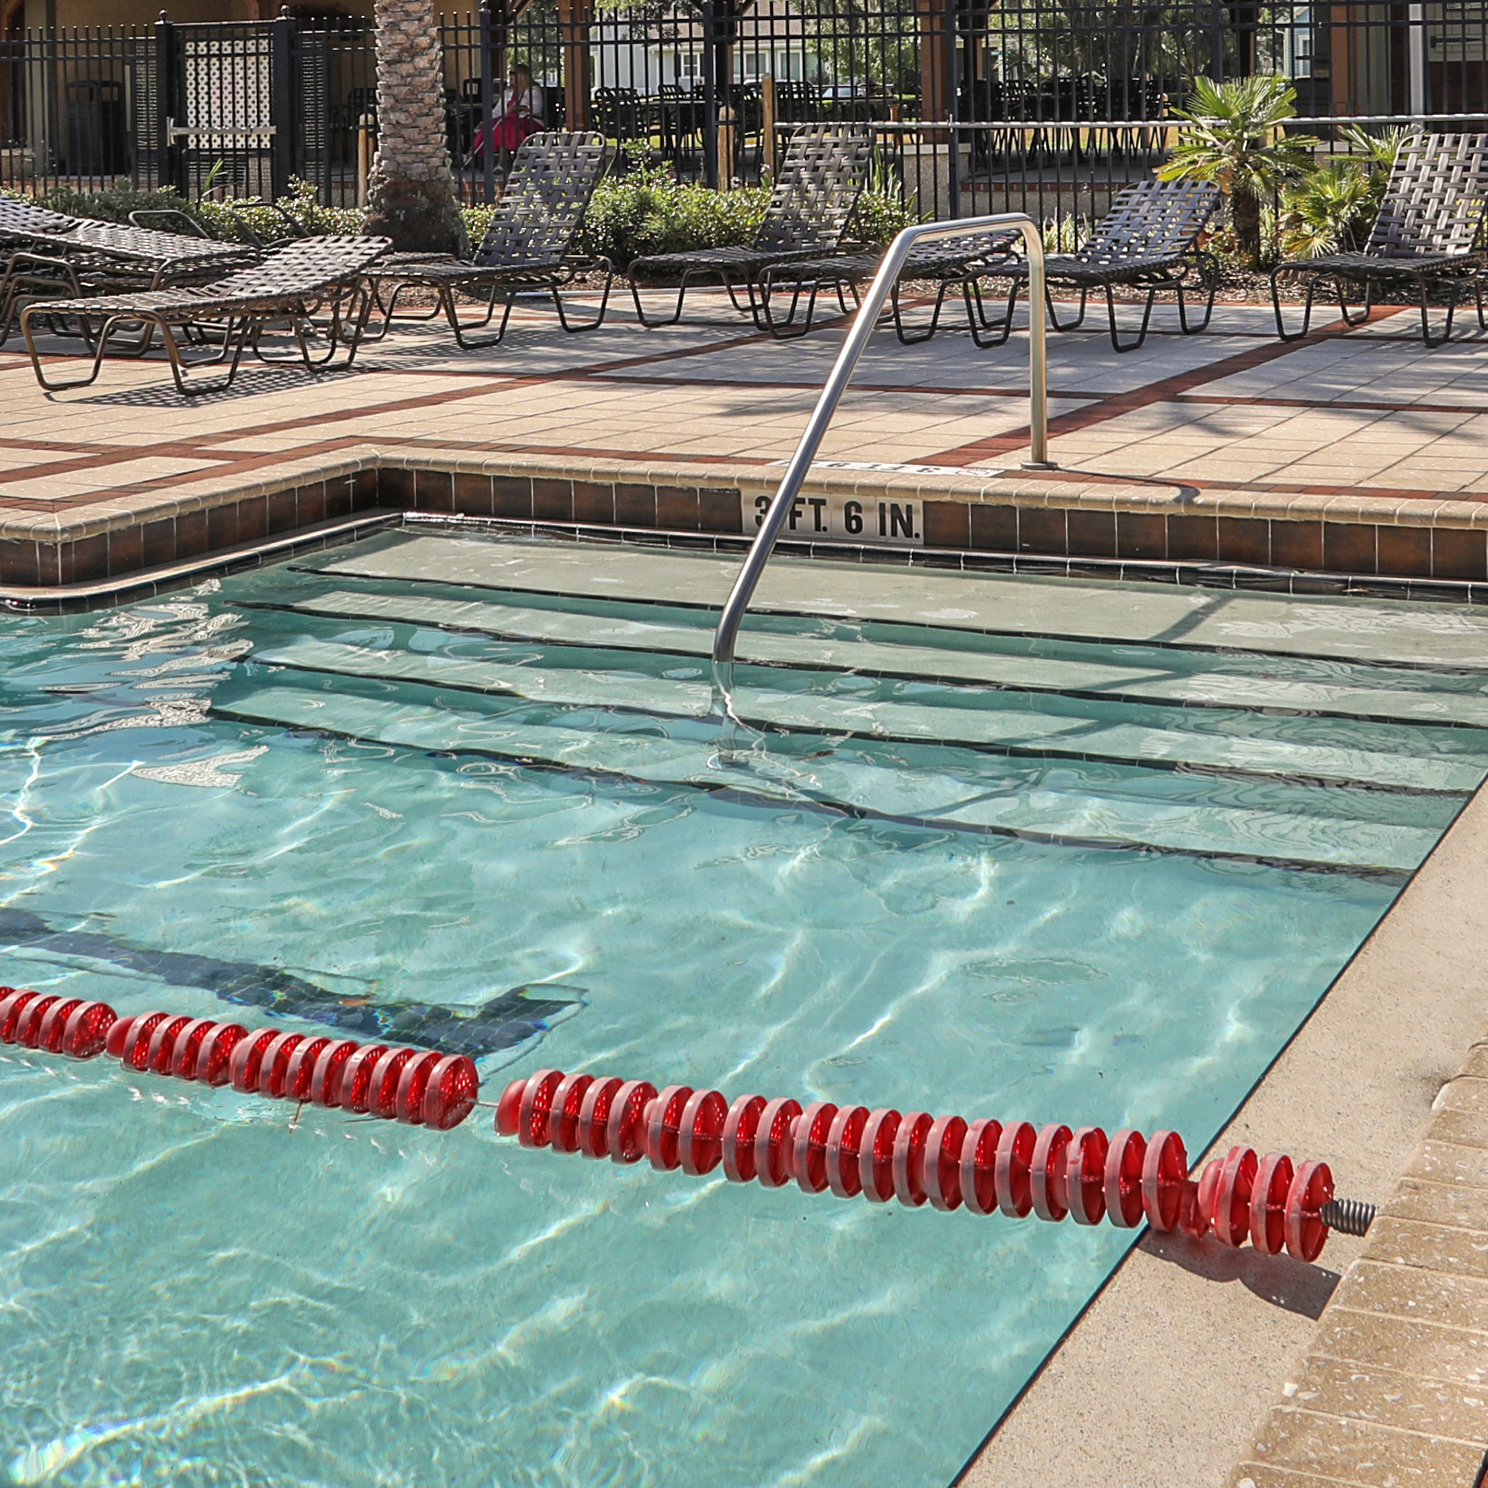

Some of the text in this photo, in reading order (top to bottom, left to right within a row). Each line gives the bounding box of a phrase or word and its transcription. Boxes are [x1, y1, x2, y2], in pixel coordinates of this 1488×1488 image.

[755, 496, 920, 539] 3 FT. 6 IN.
